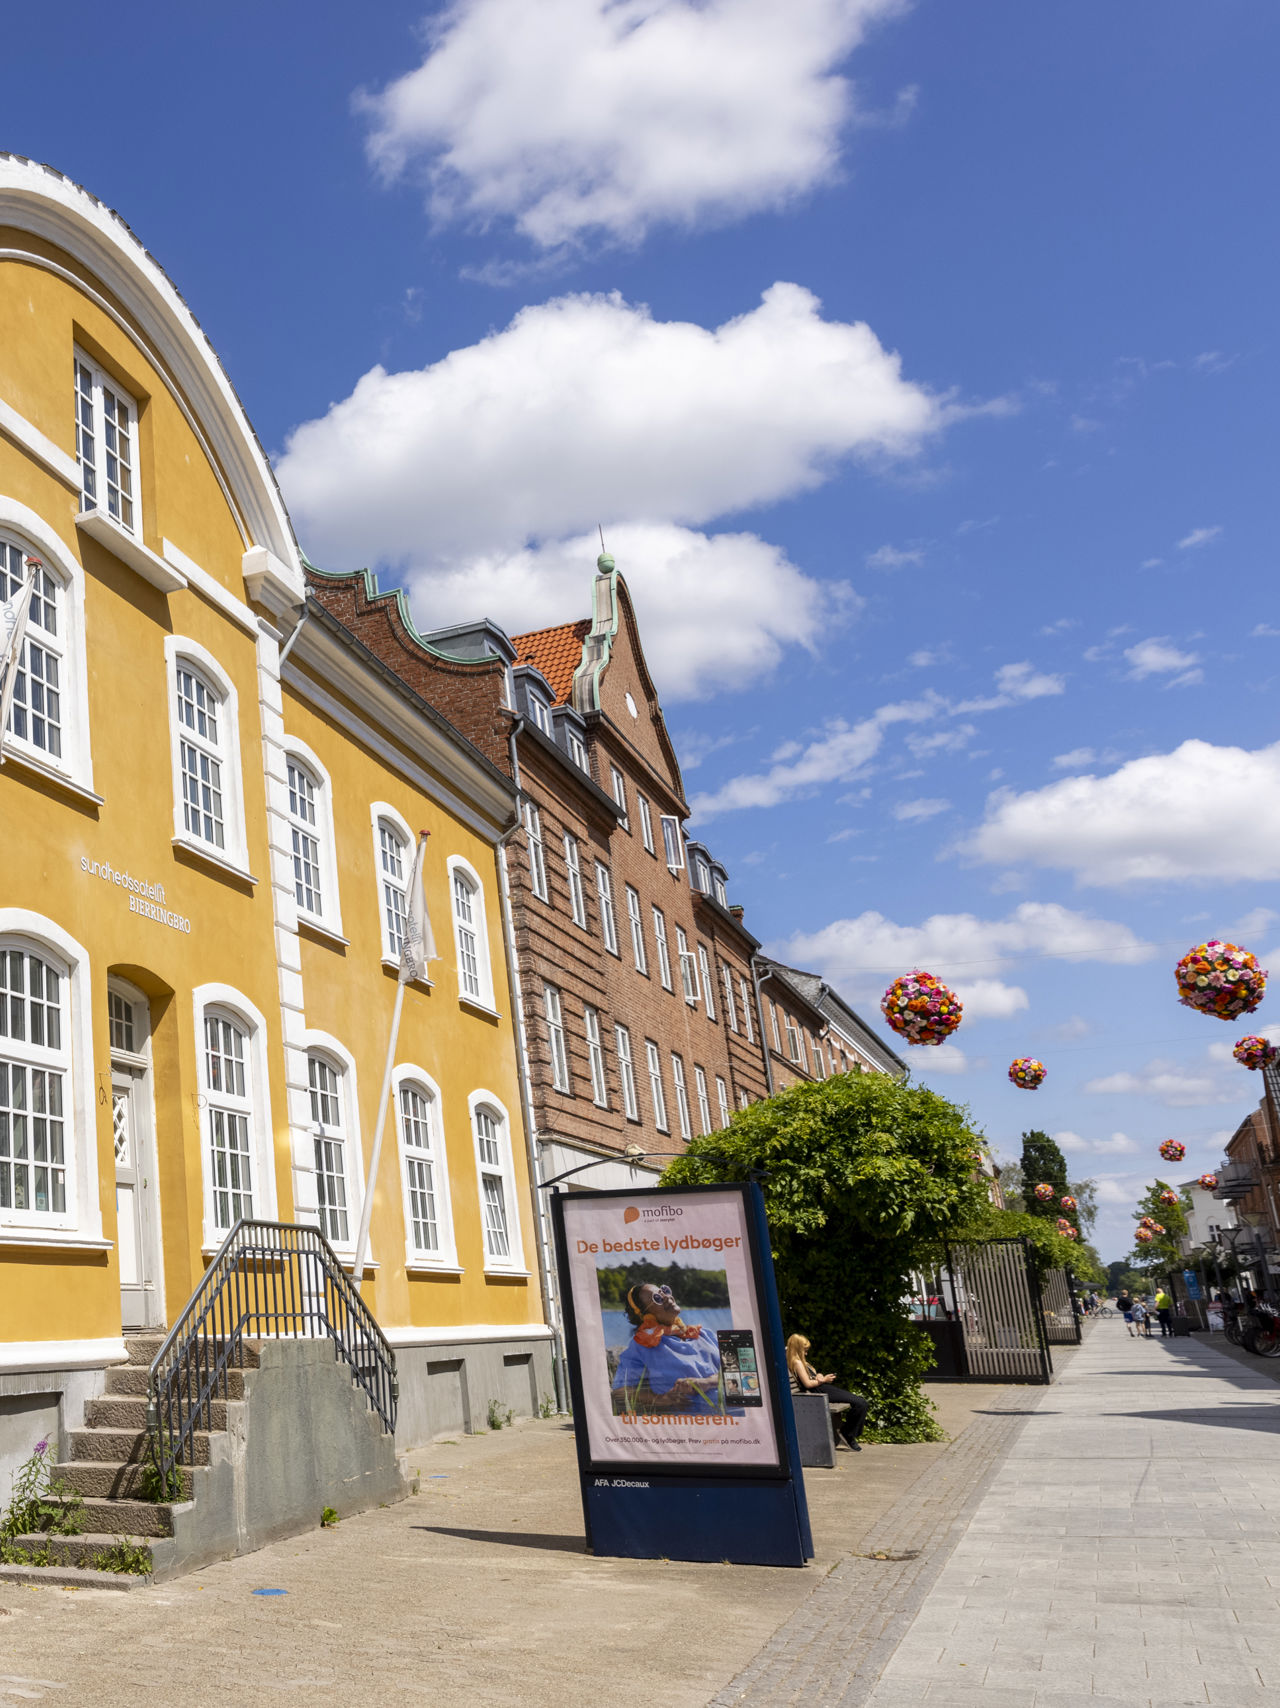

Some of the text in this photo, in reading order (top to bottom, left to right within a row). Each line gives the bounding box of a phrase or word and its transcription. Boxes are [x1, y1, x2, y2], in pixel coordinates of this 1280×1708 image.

[80, 856, 166, 905] sundhedssatellit
[128, 894, 191, 934] BJERRINGBRO
[642, 1205, 683, 1217] mofibo
[577, 1234, 741, 1254] De bedste lydbøger
[621, 1411, 739, 1426] til sommeren.
[594, 1479, 650, 1488] AFA JCDecaux
